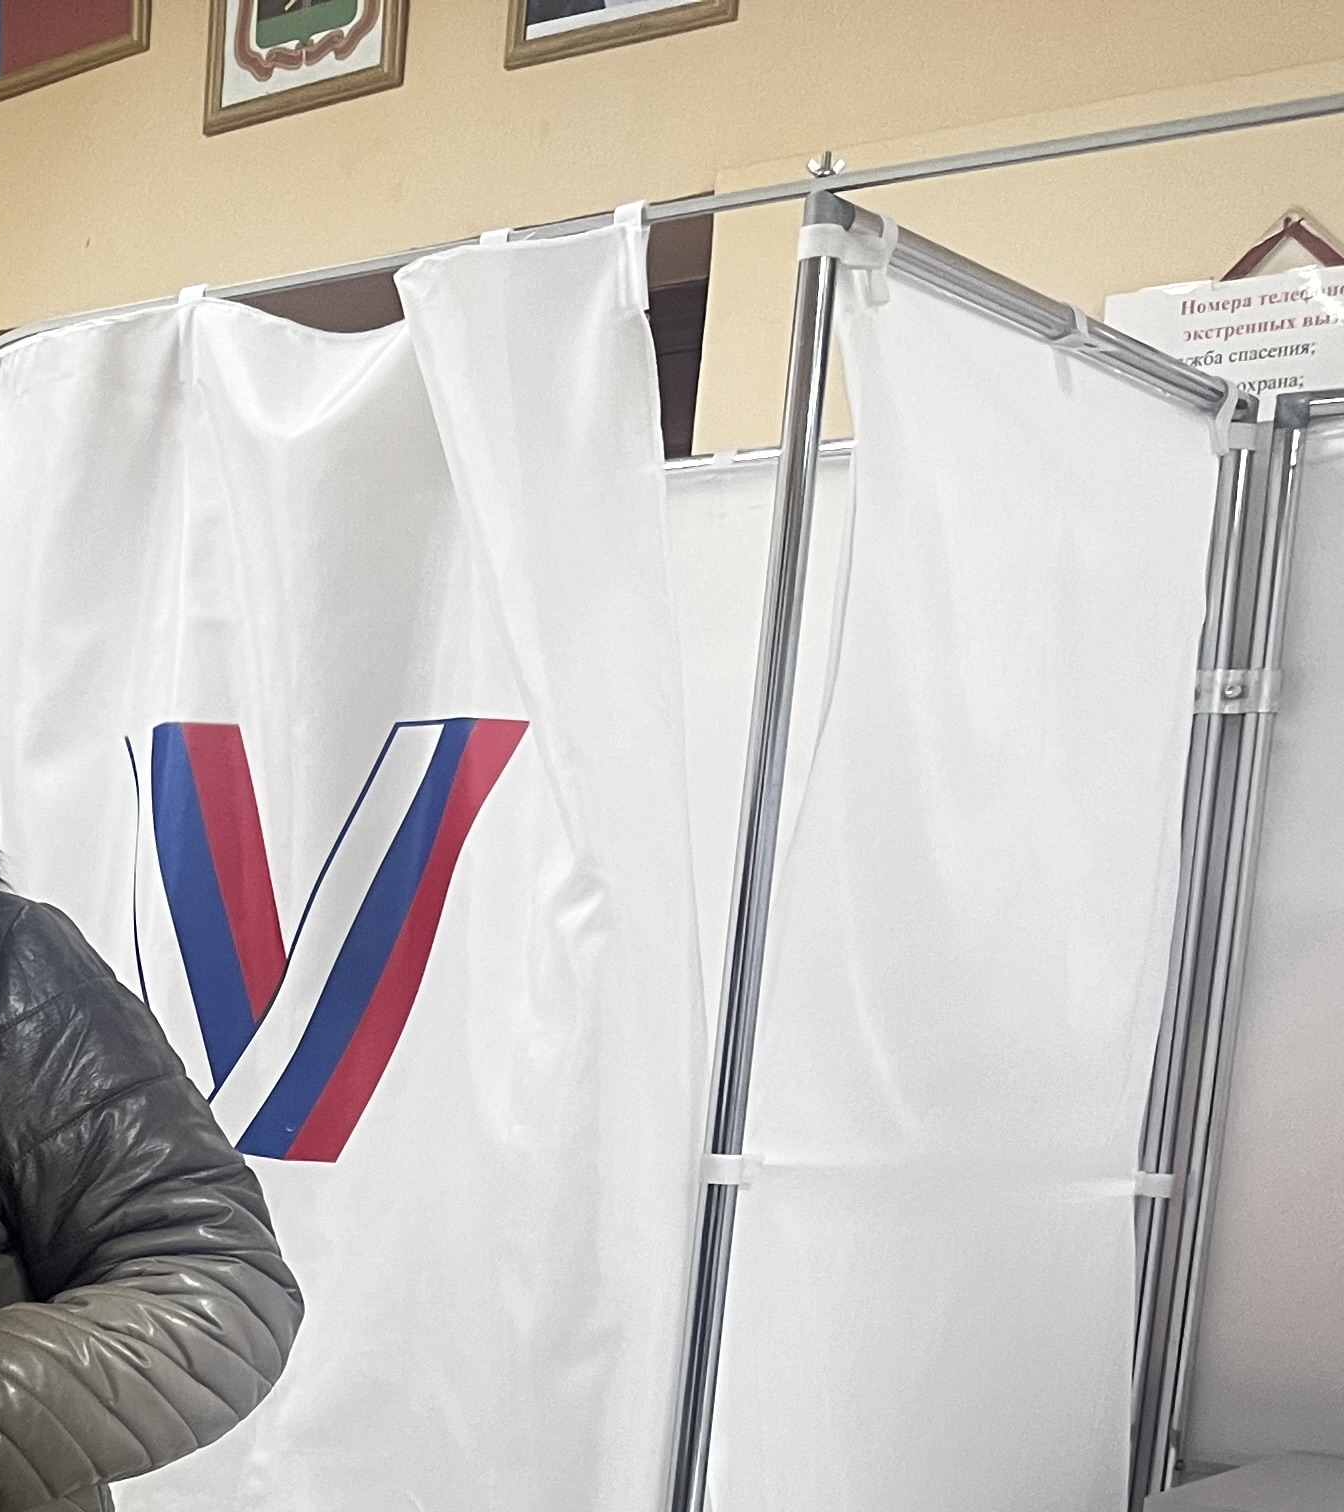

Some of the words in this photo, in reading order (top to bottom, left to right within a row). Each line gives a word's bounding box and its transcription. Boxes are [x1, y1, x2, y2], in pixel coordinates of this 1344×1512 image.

[1181, 296, 1252, 316] Номера
[1183, 317, 1297, 342] экстренных
[1228, 341, 1317, 364] спасения;
